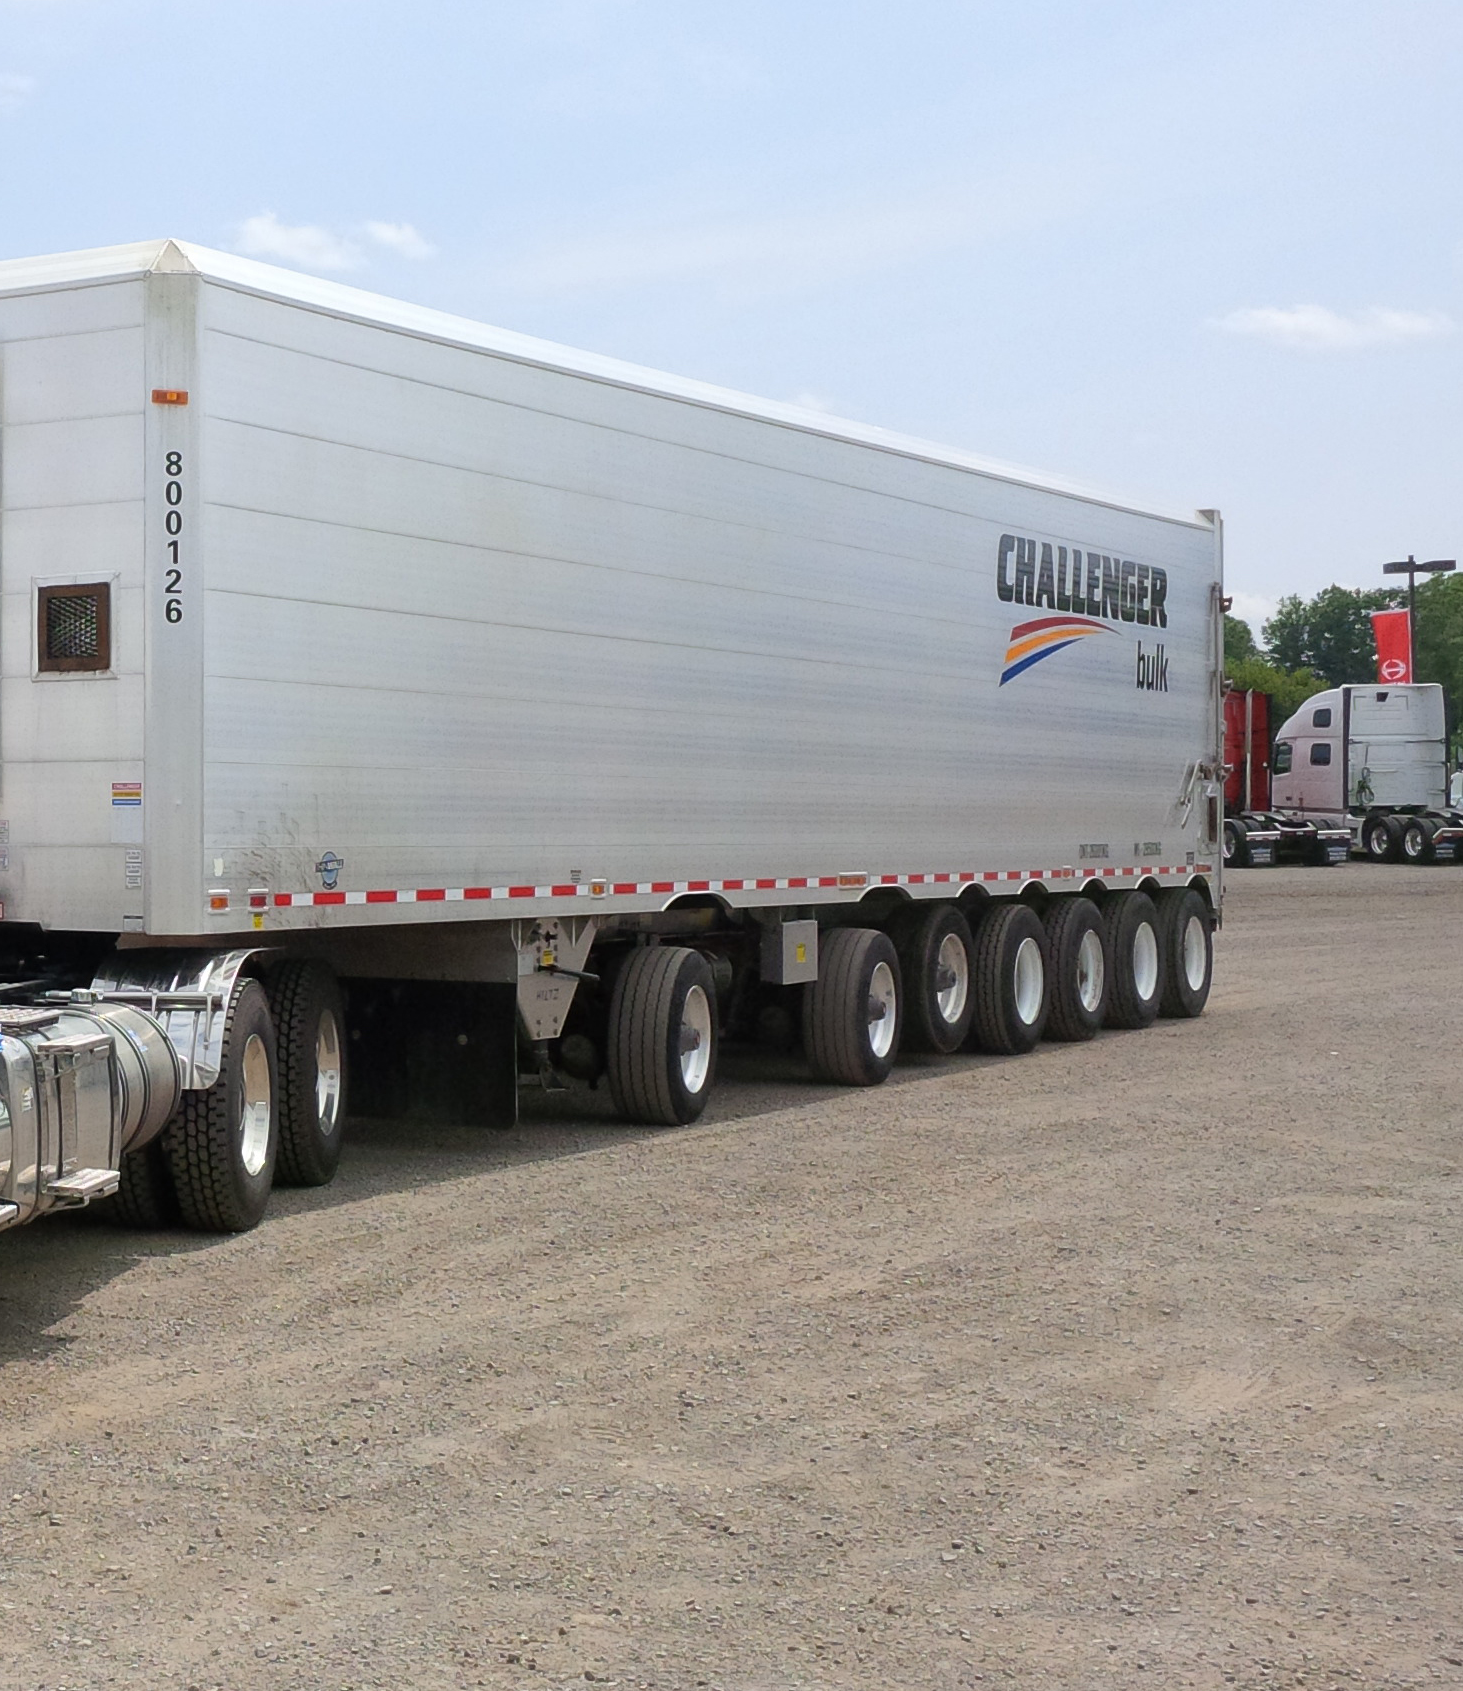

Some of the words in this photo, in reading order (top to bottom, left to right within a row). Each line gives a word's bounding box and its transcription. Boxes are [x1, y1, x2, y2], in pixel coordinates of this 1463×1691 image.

[165, 451, 183, 623] 800126
[997, 533, 1167, 628] CHALLENGER
[1137, 640, 1168, 692] bulk
